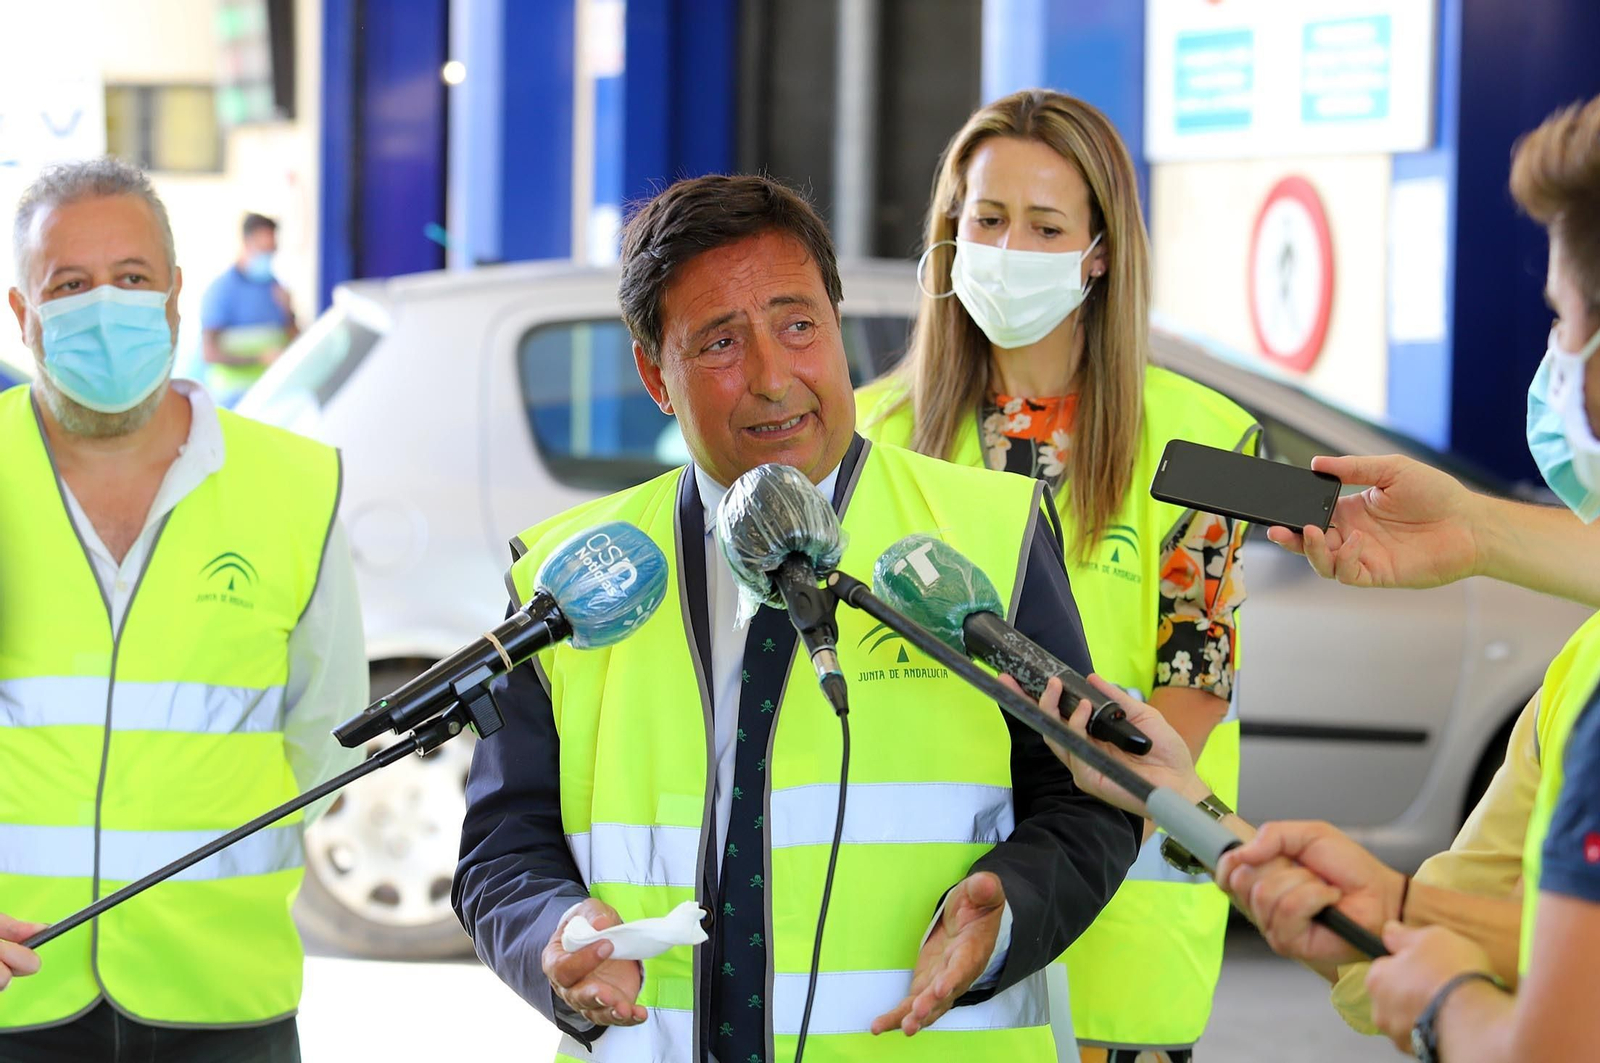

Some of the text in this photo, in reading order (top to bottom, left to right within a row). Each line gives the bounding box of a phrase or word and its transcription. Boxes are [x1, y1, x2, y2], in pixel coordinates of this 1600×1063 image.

[858, 668, 949, 682] JUNTA DE ANDALUCIA
